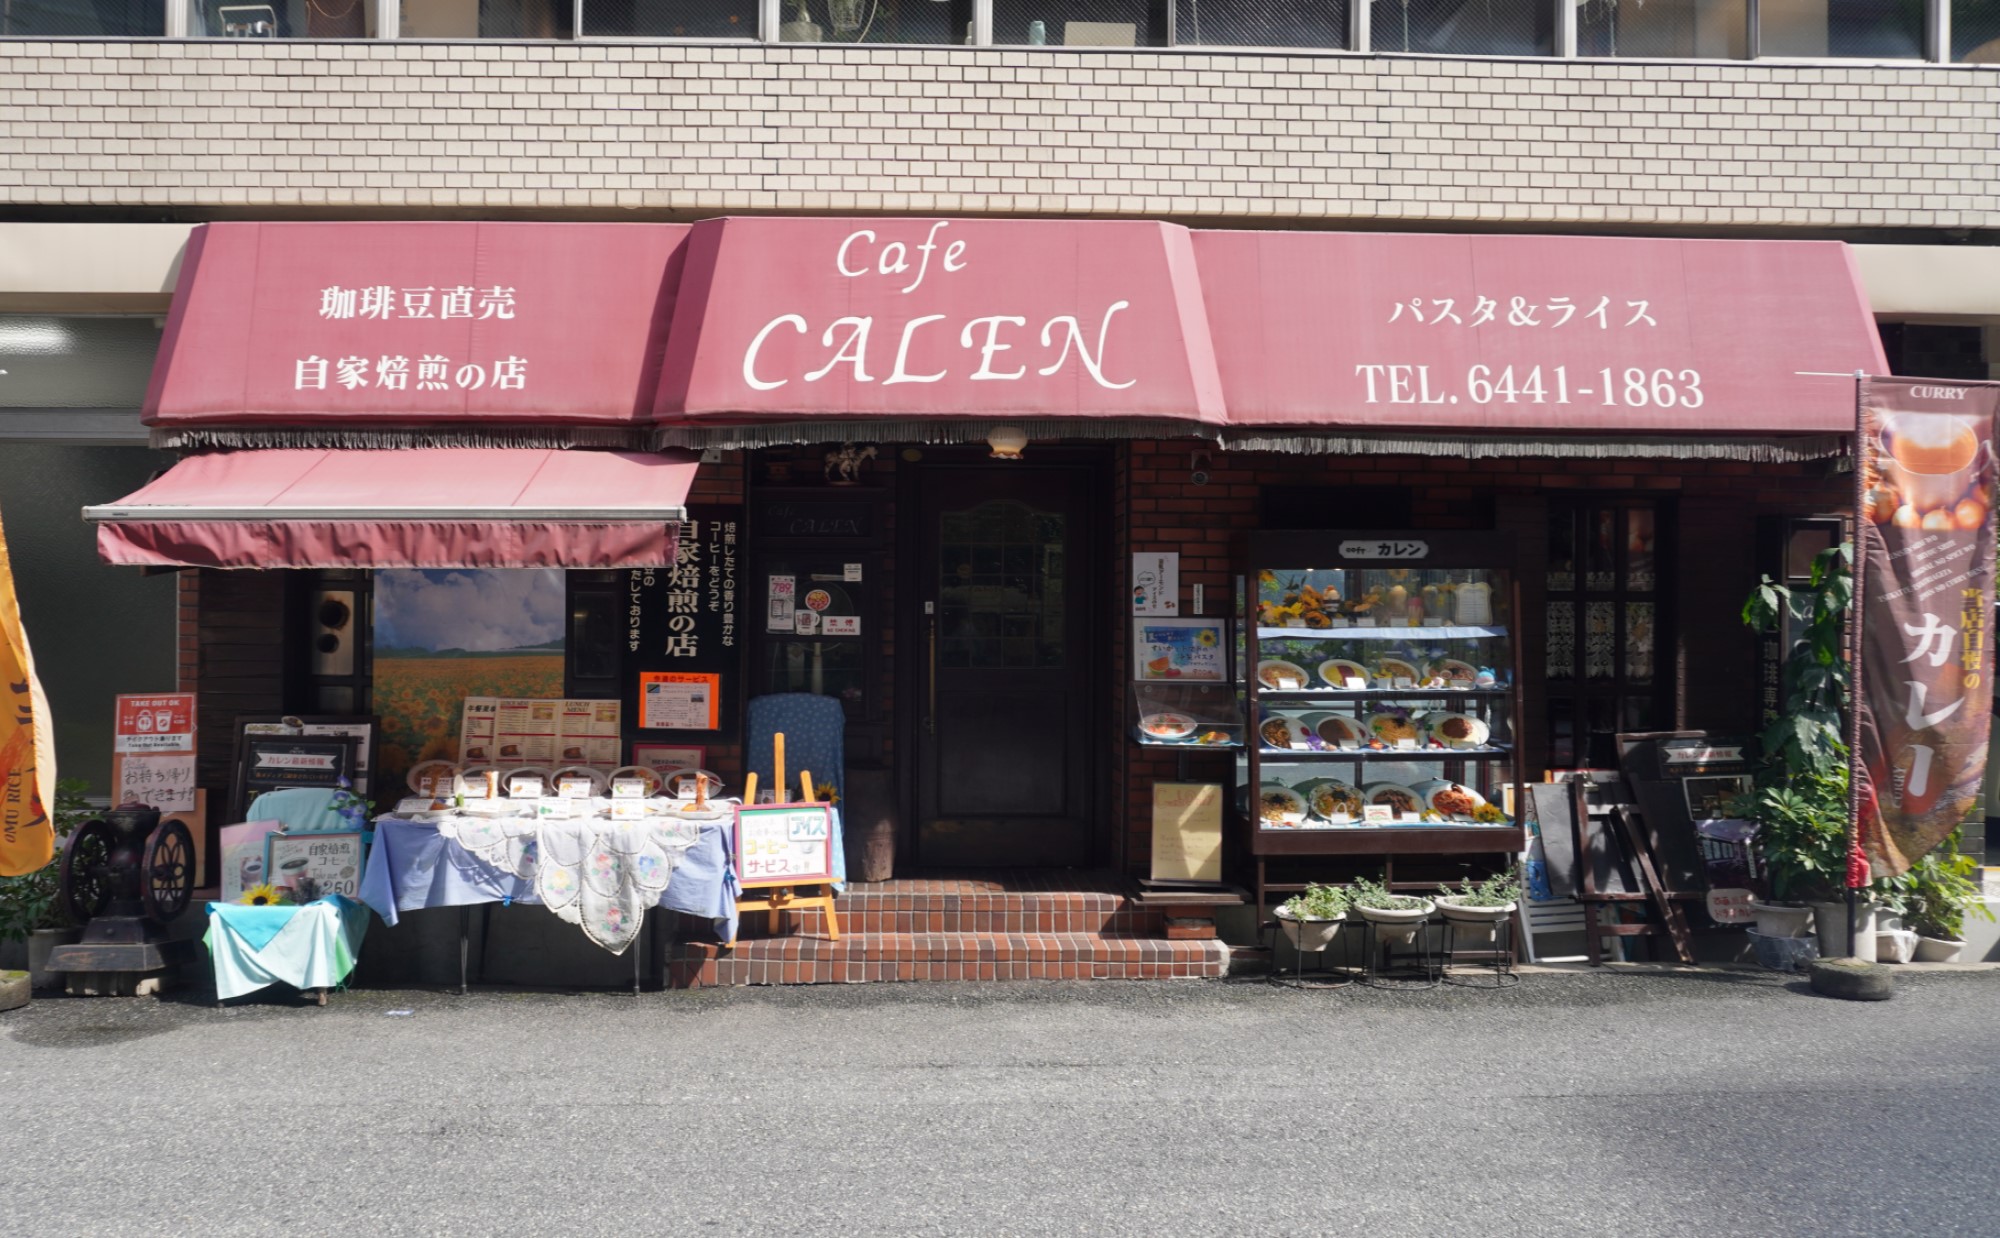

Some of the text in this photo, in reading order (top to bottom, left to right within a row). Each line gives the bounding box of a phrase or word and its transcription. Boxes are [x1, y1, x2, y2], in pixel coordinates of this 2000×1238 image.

[836, 220, 967, 294] Cafe
[319, 286, 517, 321] 珈琲豆直売
[1388, 295, 1658, 330] パスタ&ライス
[742, 300, 1137, 391] CALEN
[294, 355, 529, 391] 自家焙煎の店
[1910, 385, 1968, 400] CURRY
[708, 521, 721, 612] コーヒーをどうぞ
[1378, 542, 1421, 556] カレン
[665, 520, 701, 657] 自家焙煎の店
[722, 521, 736, 647] 焙煎したての香り豊かな
[1960, 588, 1985, 690] 当店自慢の
[1898, 612, 1966, 798] カレー
[7, 768, 22, 805] RICE
[791, 815, 827, 836] アイス
[308, 843, 351, 857] 自家焙煎
[745, 839, 789, 856] コーヒー
